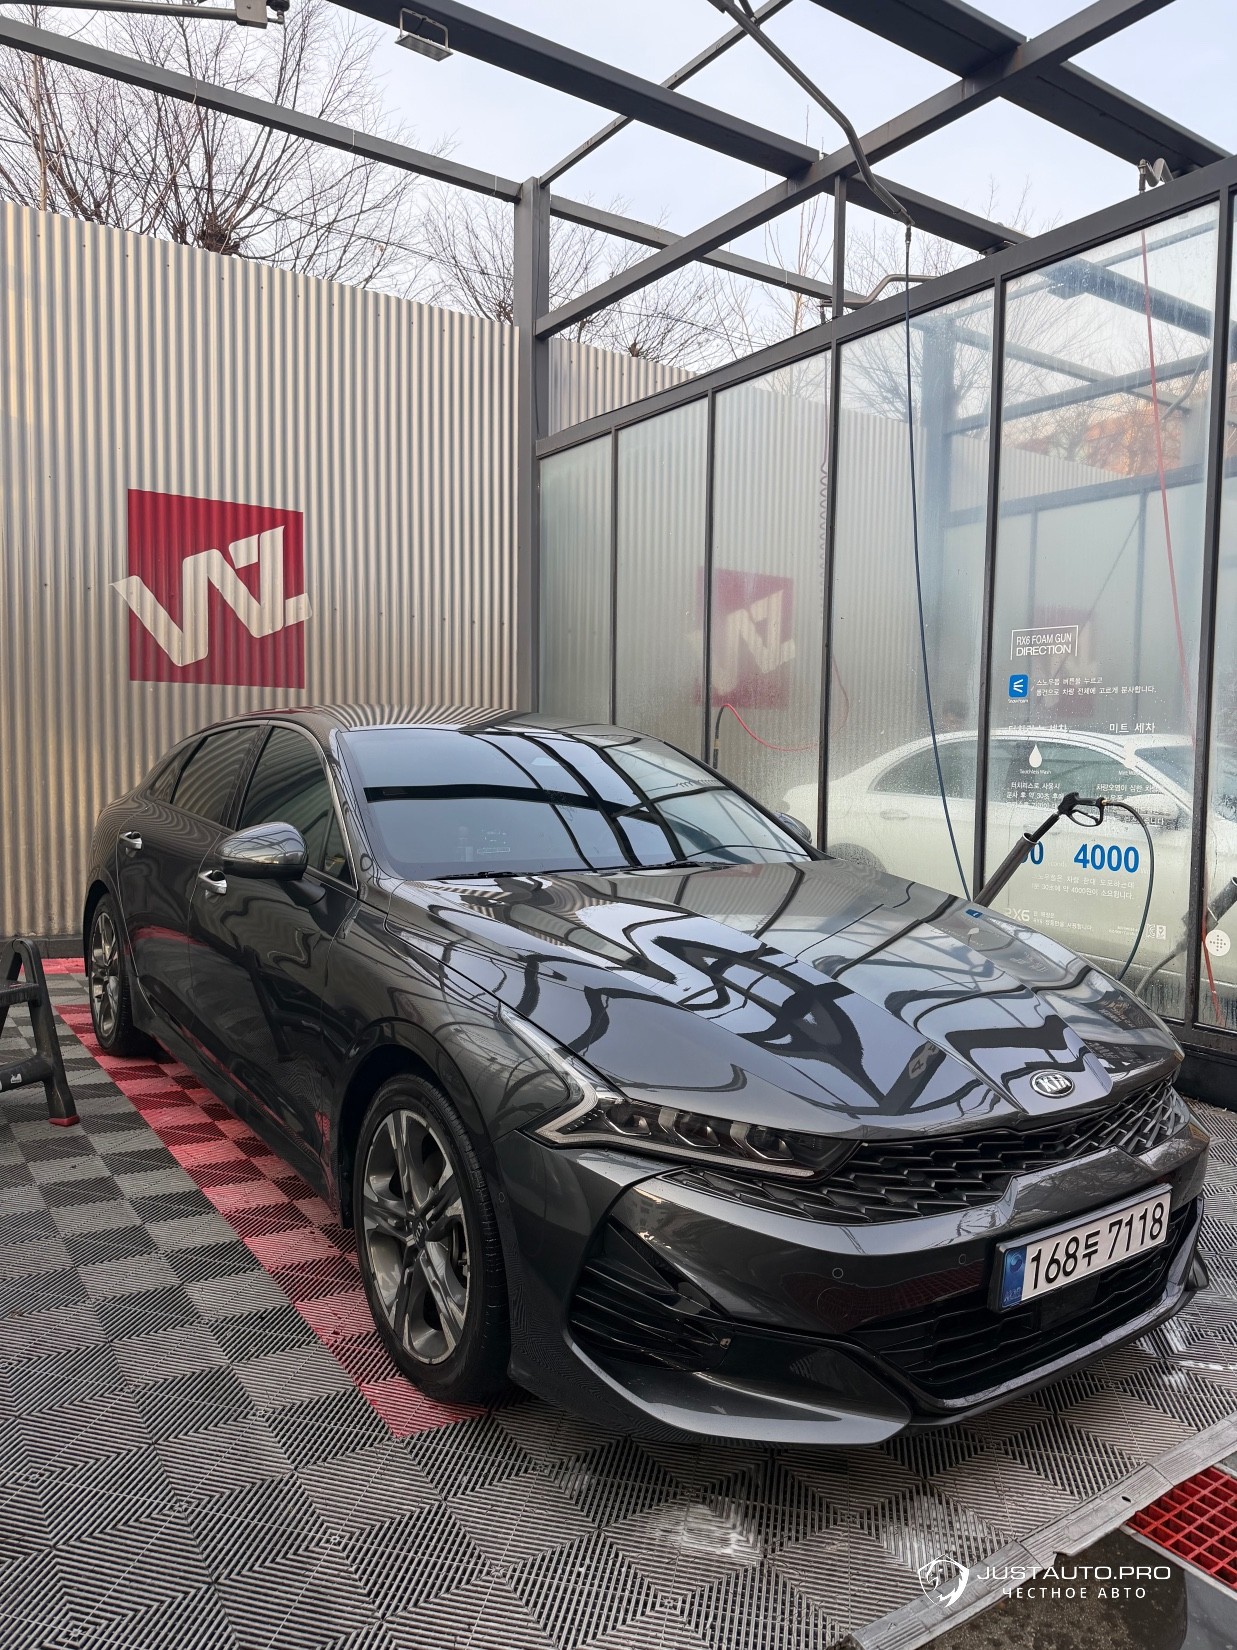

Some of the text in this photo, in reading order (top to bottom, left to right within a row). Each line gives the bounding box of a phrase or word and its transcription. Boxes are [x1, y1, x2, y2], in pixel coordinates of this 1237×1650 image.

[1016, 632, 1072, 646] RX6 FOAM GUN
[1016, 643, 1072, 657] DIRECTION
[1109, 722, 1156, 734] 미트 세차
[1074, 843, 1140, 873] 4000
[1036, 1074, 1072, 1092] KIA
[1030, 1201, 1165, 1290] 168두 7118
